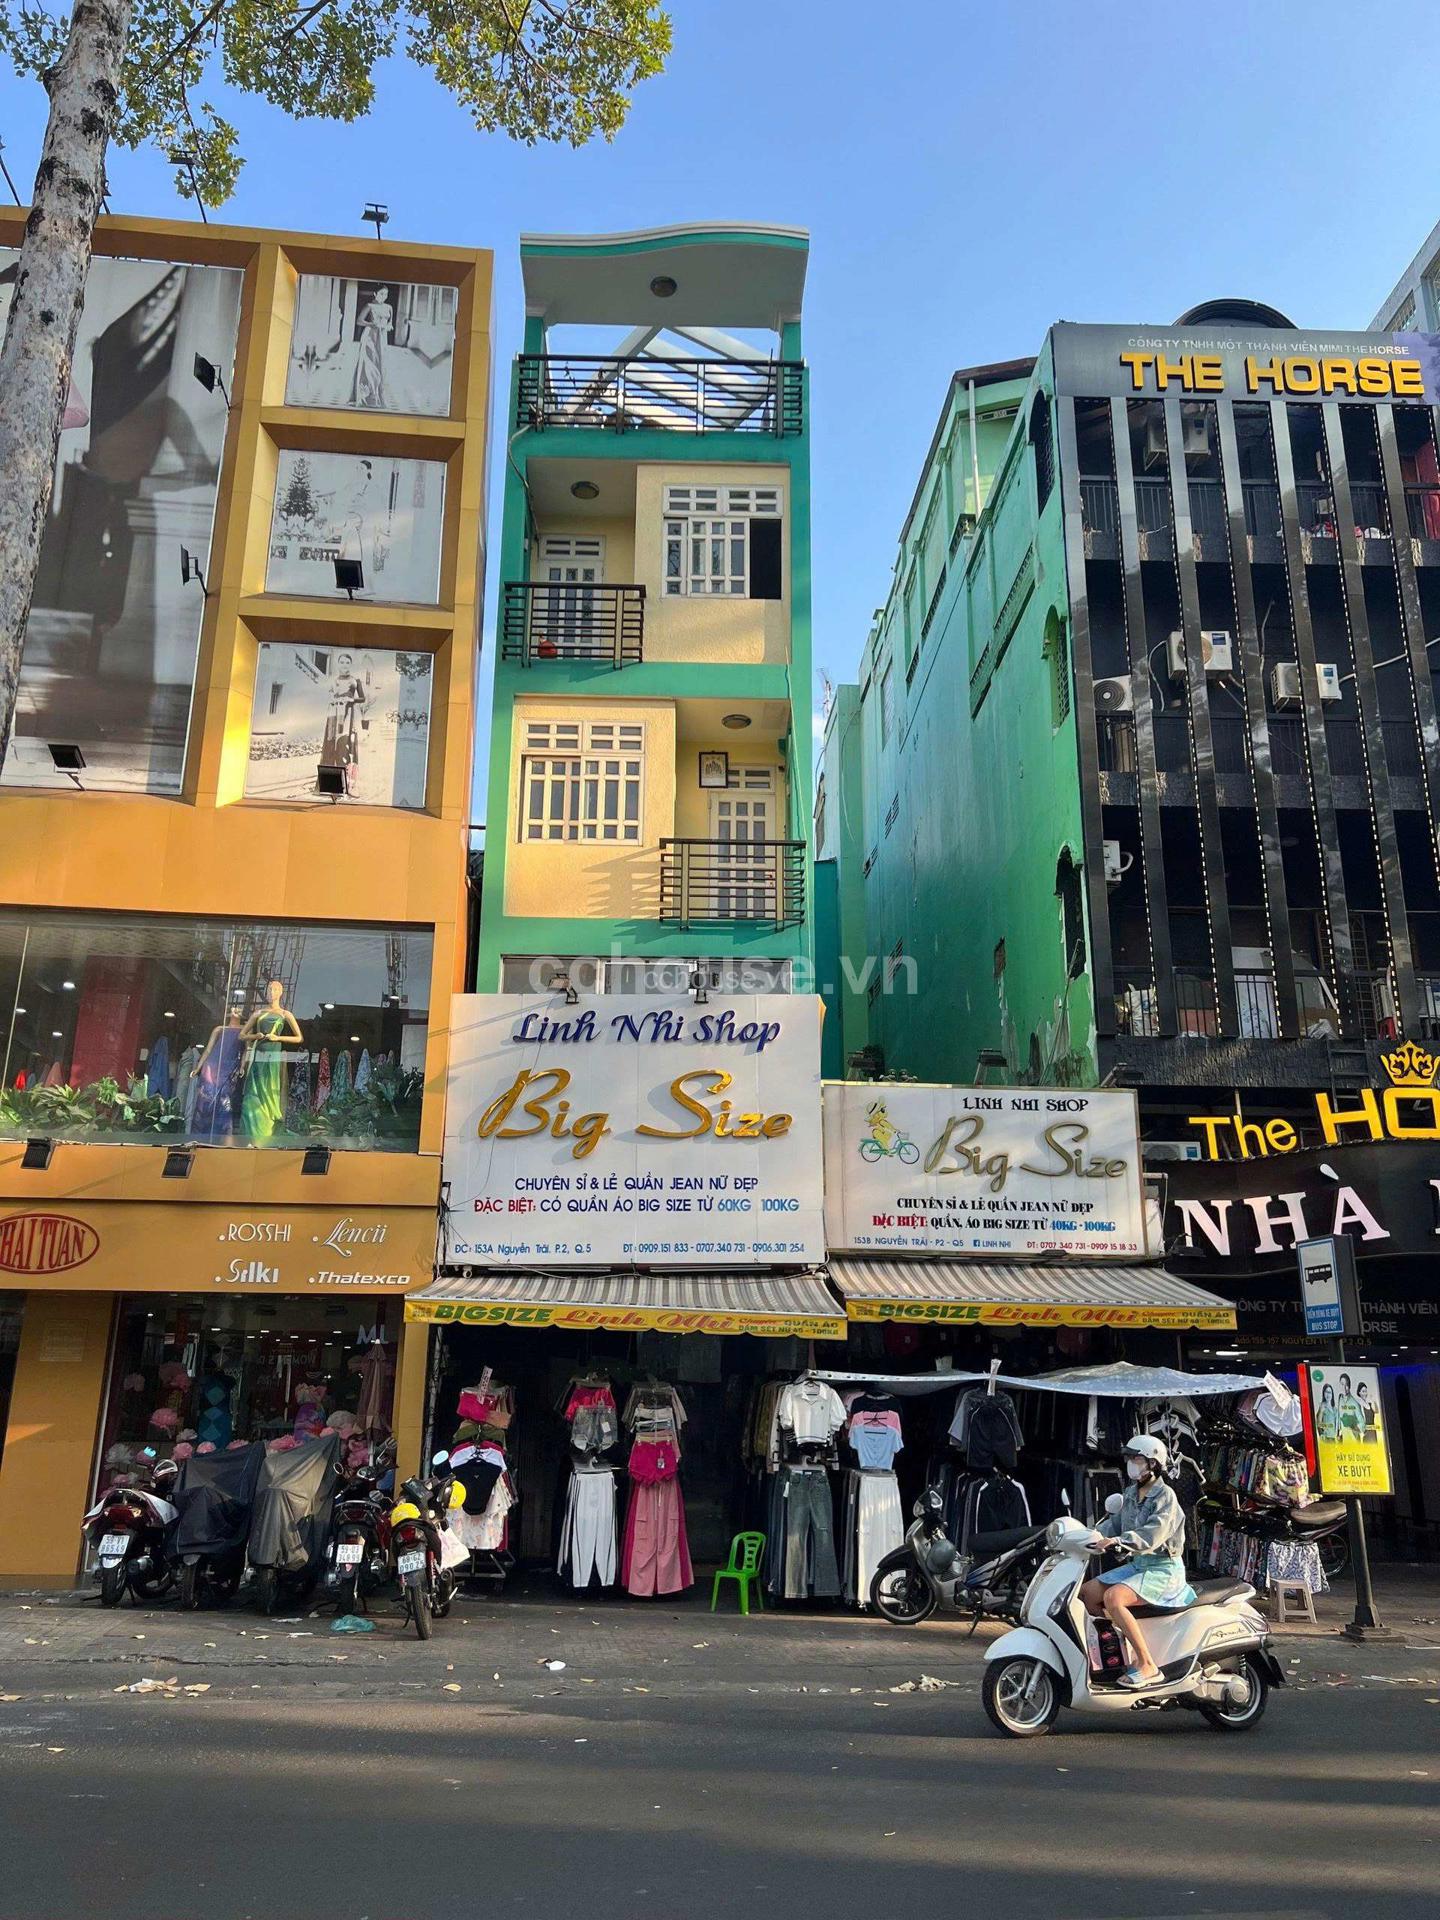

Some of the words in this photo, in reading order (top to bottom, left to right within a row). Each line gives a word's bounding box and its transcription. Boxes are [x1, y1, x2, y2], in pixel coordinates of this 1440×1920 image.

[1128, 336, 1162, 348] CÔNG
[1164, 339, 1179, 348] TY
[1183, 340, 1214, 349] TNHH
[1217, 338, 1242, 352] MỘT
[1246, 339, 1287, 351] THÀNH
[1290, 340, 1317, 352] VIÊN
[1319, 343, 1343, 353] MIMI
[1344, 344, 1368, 354] THE
[1369, 345, 1410, 355] HORSE
[1120, 352, 1224, 393] THE
[1245, 355, 1425, 398] HORSE
[512, 1010, 601, 1044] Linh
[611, 1010, 684, 1042] Nhi
[692, 1010, 782, 1053] Shop
[477, 1067, 612, 1159] Big
[635, 1069, 793, 1138] Size
[962, 1097, 1002, 1110] LINH
[1011, 1098, 1040, 1111] NHI
[1046, 1098, 1089, 1112] SHOP
[1188, 1115, 1297, 1160] The
[924, 1114, 1013, 1193] Big
[1019, 1121, 1128, 1178] Size
[515, 1175, 570, 1190] CHUYÊN
[576, 1173, 587, 1190] SỈ
[590, 1178, 599, 1190] &
[603, 1172, 617, 1190] LẺ
[624, 1171, 663, 1192] QUẦN
[670, 1177, 703, 1190] JEAN
[709, 1175, 728, 1190] NỮ
[734, 1177, 759, 1193] ĐẸP
[474, 1197, 503, 1214] ĐẶC
[508, 1196, 536, 1214] BIỆT:
[540, 1196, 562, 1212] CÓ
[567, 1194, 608, 1213] QUẦN
[613, 1196, 633, 1212] ÁO
[638, 1199, 660, 1212] BIG
[666, 1199, 691, 1212] SIZE
[697, 1195, 714, 1212] TỪ
[717, 1199, 751, 1212] 60KG
[760, 1199, 799, 1212] 100KG
[896, 1196, 943, 1209] CHUYÊN
[959, 1200, 969, 1210] &
[1020, 1201, 1049, 1212] JEAN
[1174, 1163, 1390, 1256] NHÀ
[965, 1215, 980, 1229] ÁO
[983, 1218, 1002, 1230] BIG
[1005, 1219, 1030, 1230] SIZE
[1032, 1216, 1048, 1230] TỪ
[36, 1219, 86, 1270] TUAN
[475, 1244, 493, 1254] 153A
[497, 1242, 531, 1256] Nguyễn
[638, 1243, 671, 1253] 0909.151
[674, 1243, 689, 1253] 833
[695, 1243, 731, 1253] 0707.340
[734, 1243, 746, 1253] 731
[752, 1243, 787, 1253] 0906.301
[789, 1243, 805, 1253] 254
[854, 1236, 871, 1245] 153B
[952, 1239, 964, 1247] Q5
[982, 1240, 998, 1248] LINH
[999, 1240, 1011, 1248] NHI
[1040, 1241, 1057, 1249] 0707
[1128, 1243, 1138, 1251] 33
[434, 1304, 554, 1322] BIGSIZE
[878, 1304, 982, 1319] BIGSIZE
[1311, 1322, 1323, 1331] BUS
[1324, 1320, 1338, 1330] STOP
[1338, 1466, 1348, 1477] XE
